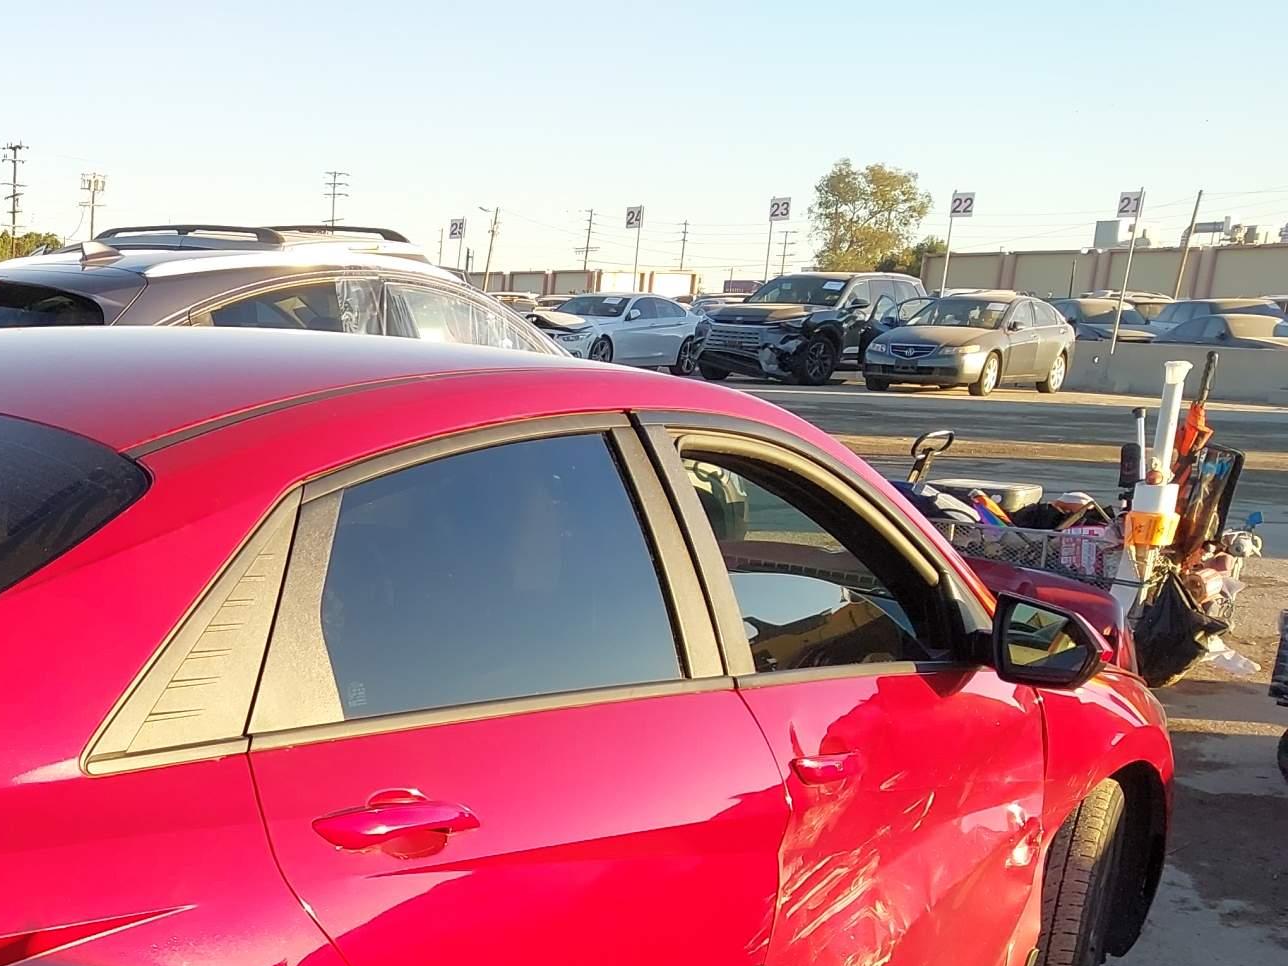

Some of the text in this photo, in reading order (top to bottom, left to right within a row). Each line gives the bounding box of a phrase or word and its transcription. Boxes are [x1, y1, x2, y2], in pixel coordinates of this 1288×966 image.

[771, 202, 790, 217] 23
[952, 197, 973, 213] 22
[1119, 197, 1140, 213] 21
[627, 210, 642, 225] 24
[451, 222, 464, 236] 25
